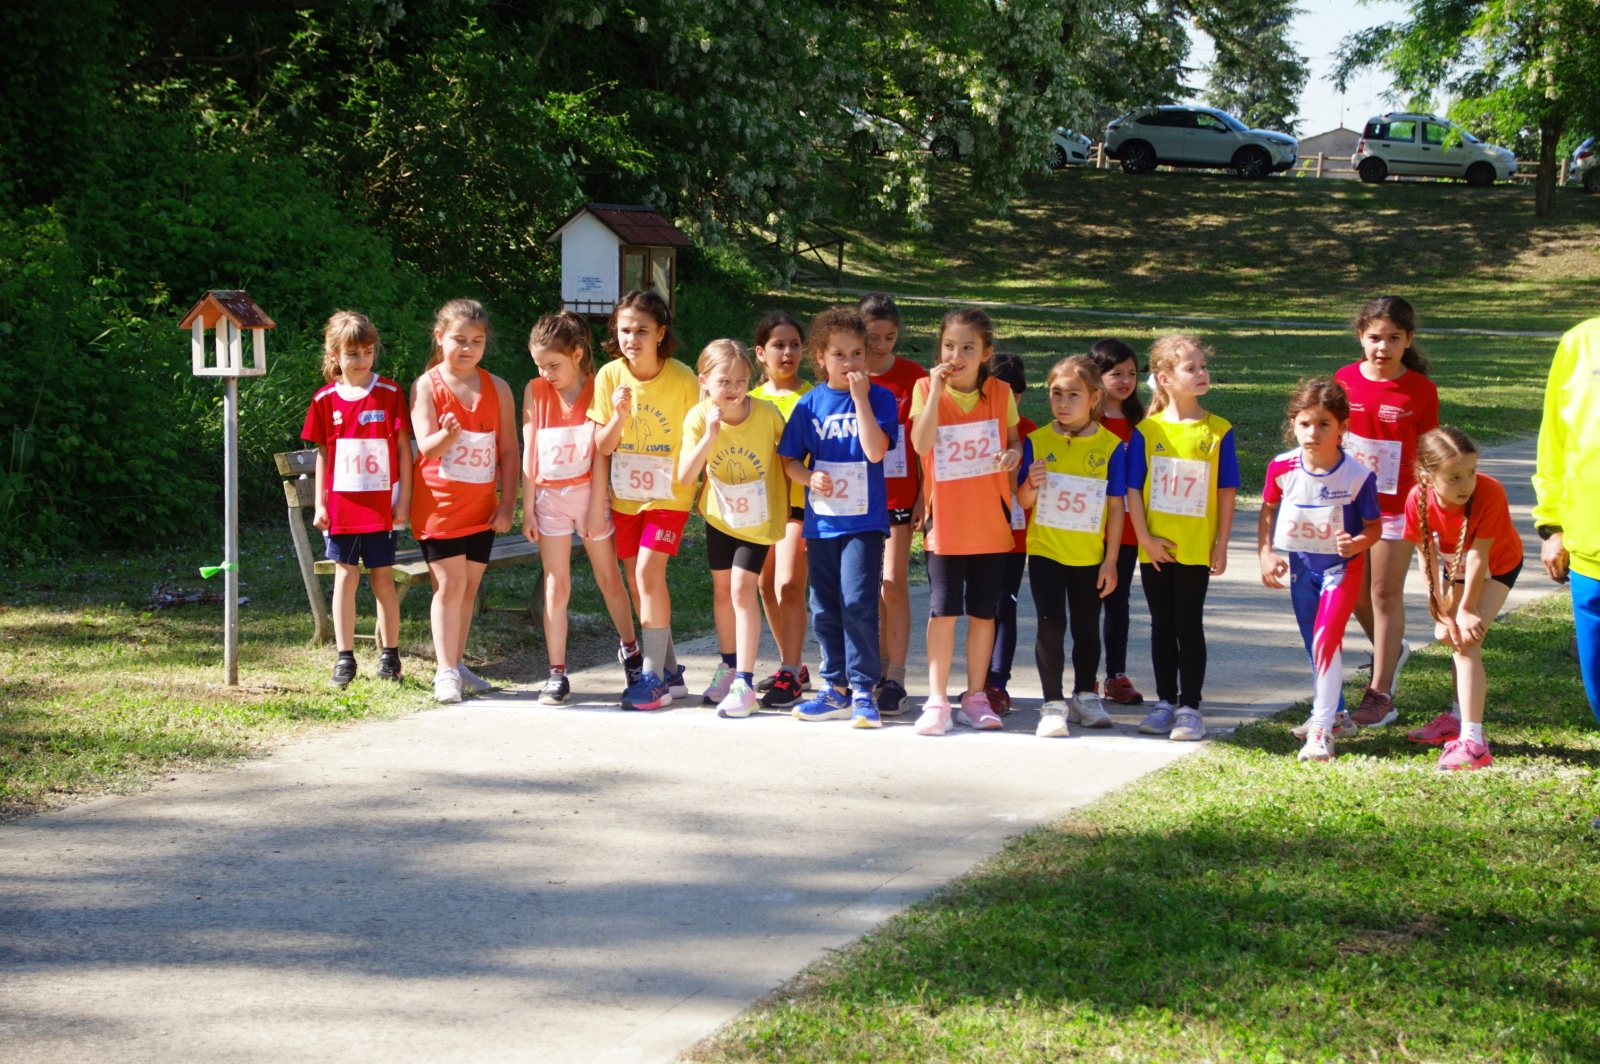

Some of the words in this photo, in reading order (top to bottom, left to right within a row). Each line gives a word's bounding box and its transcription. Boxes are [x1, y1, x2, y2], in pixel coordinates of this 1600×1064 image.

[812, 412, 857, 440] VAN
[453, 445, 491, 468] 253
[947, 437, 991, 463] 252
[343, 454, 379, 475] 116
[629, 469, 655, 491] 59
[1161, 473, 1197, 498] 117
[724, 496, 749, 514] 58
[1056, 490, 1087, 514] 55
[1286, 519, 1332, 540] 259
